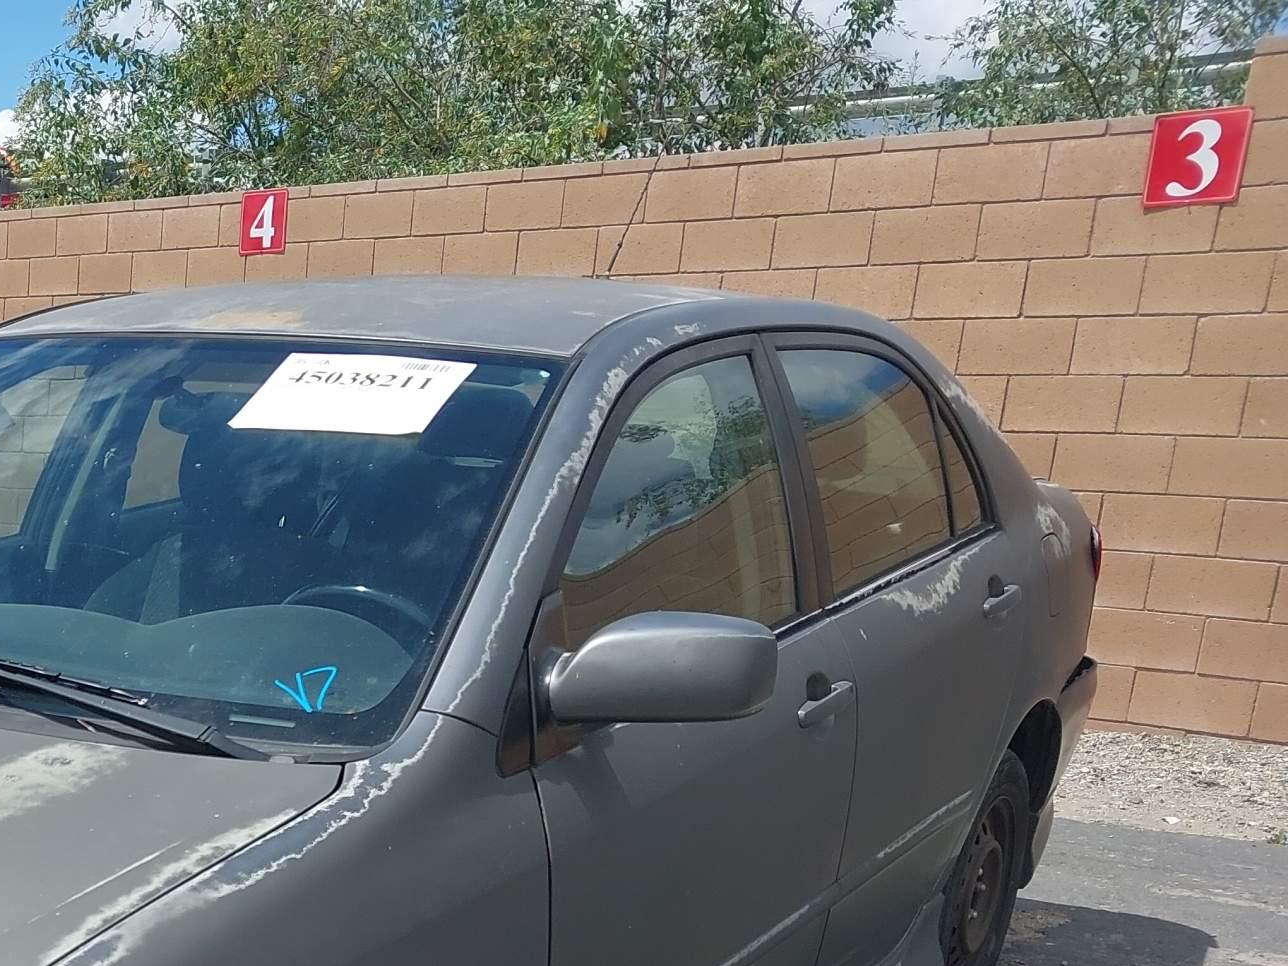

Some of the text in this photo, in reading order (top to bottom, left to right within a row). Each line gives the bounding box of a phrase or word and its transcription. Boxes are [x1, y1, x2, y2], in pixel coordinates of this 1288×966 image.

[1165, 118, 1223, 197] 3
[249, 194, 276, 249] 4
[288, 368, 433, 391] 45038211
